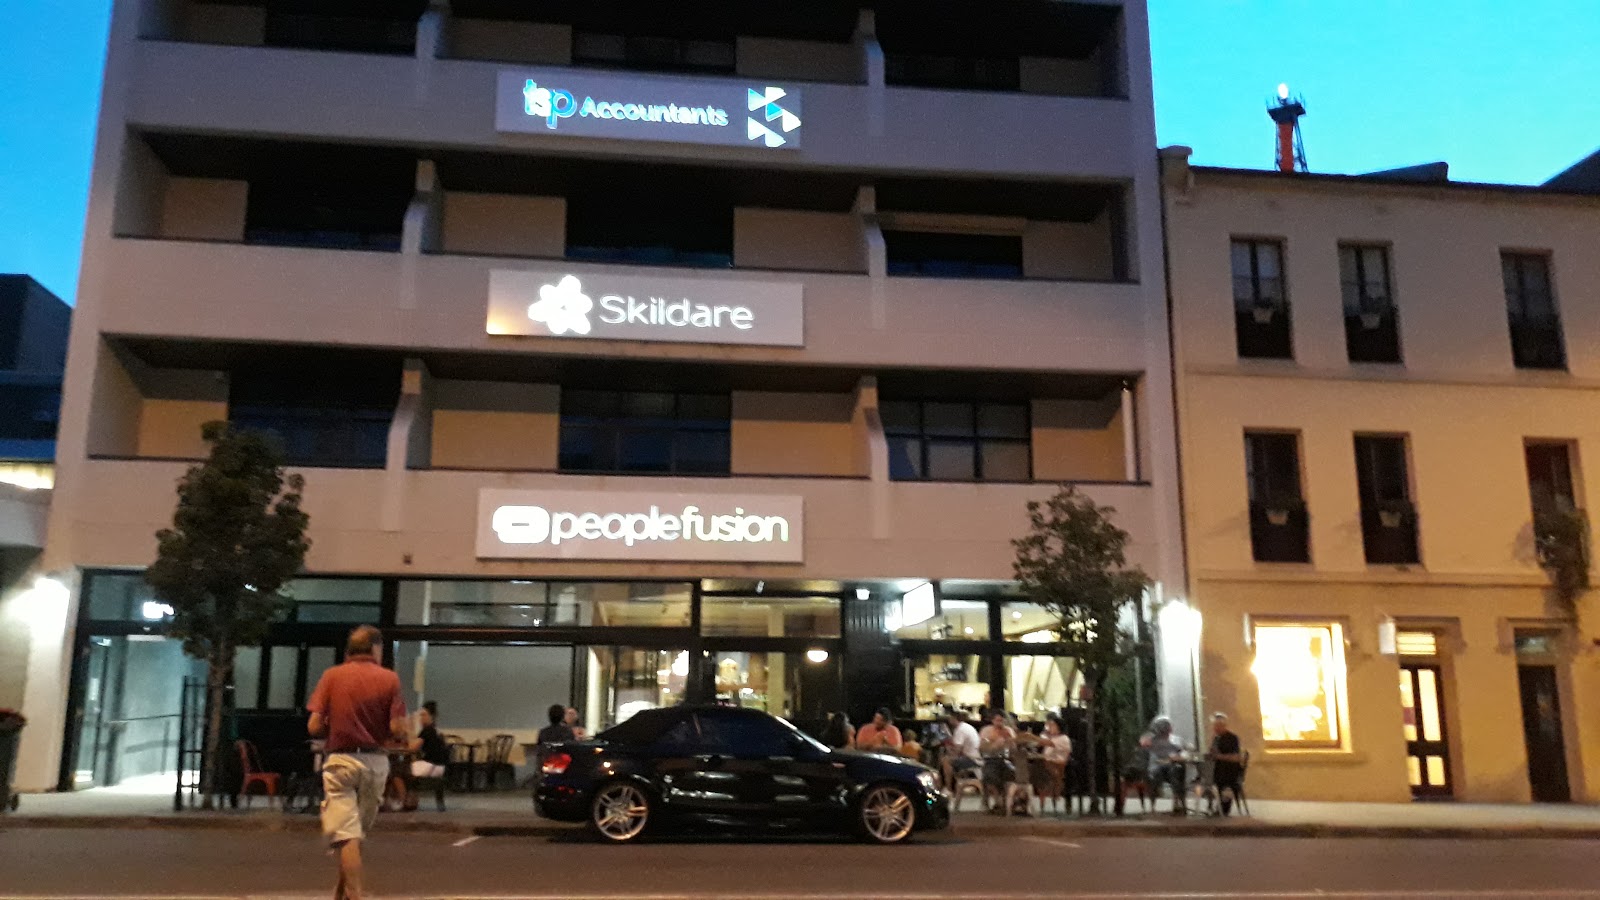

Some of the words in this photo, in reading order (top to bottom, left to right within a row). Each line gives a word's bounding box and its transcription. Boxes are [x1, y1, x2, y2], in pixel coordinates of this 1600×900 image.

[579, 96, 729, 127] Accountants
[599, 295, 754, 330] Skildare
[551, 505, 789, 546] peoplefusion
